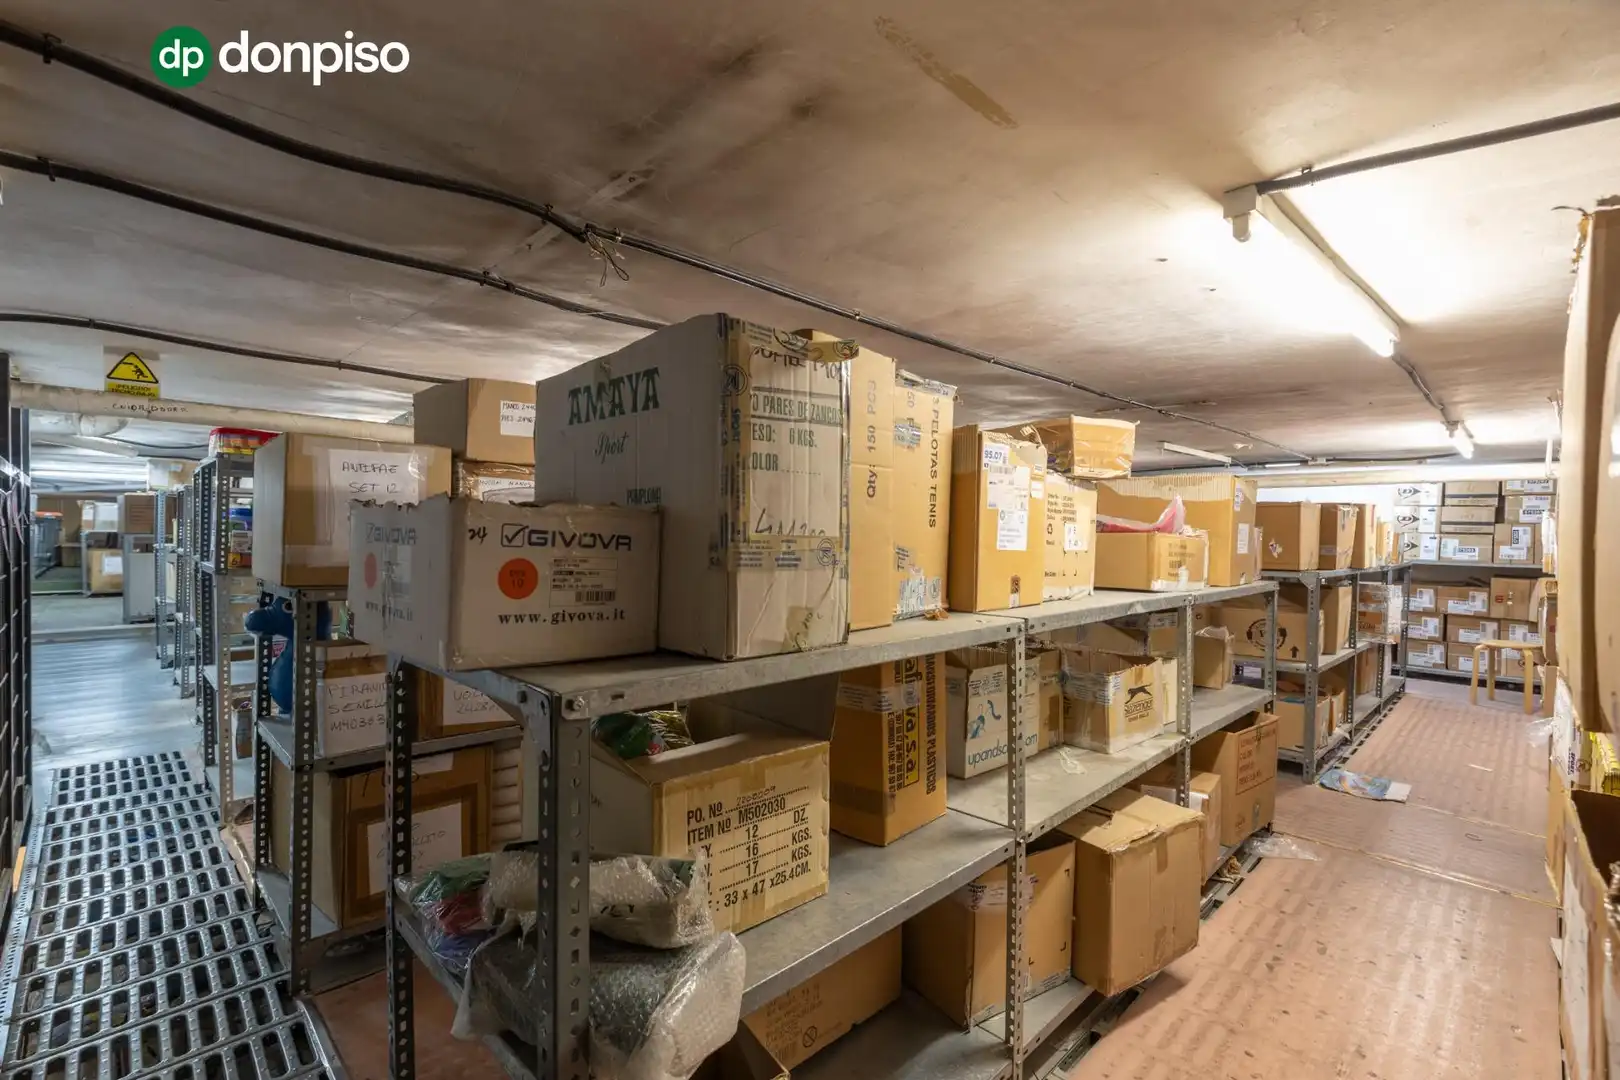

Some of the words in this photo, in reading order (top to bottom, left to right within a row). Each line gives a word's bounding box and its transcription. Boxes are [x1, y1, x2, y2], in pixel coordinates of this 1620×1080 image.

[568, 366, 660, 426] AMAYA
[763, 395, 794, 417] PARES
[798, 400, 808, 420] DE
[594, 431, 630, 464] Sport
[751, 423, 776, 443] ESO:
[867, 425, 877, 453] 150
[930, 408, 940, 480] PELOTAS
[751, 451, 779, 472] OLOR
[349, 481, 380, 494] SET
[386, 483, 401, 494] 12
[928, 484, 938, 528] TENIS
[467, 526, 488, 545] 24
[527, 529, 632, 551] GIVOVA
[497, 608, 626, 626] www.givova.it
[926, 739, 937, 795] PLASTICOS
[687, 807, 705, 827] PO.
[687, 826, 714, 846] ITEM
[738, 797, 786, 825] M502030
[745, 824, 759, 840] 12
[793, 808, 809, 825] DZ.
[745, 842, 759, 858] 16
[791, 827, 812, 847] KGS.
[745, 860, 759, 877] 17
[791, 844, 812, 863] KGS.
[724, 890, 738, 908] 33
[752, 879, 765, 896] 47
